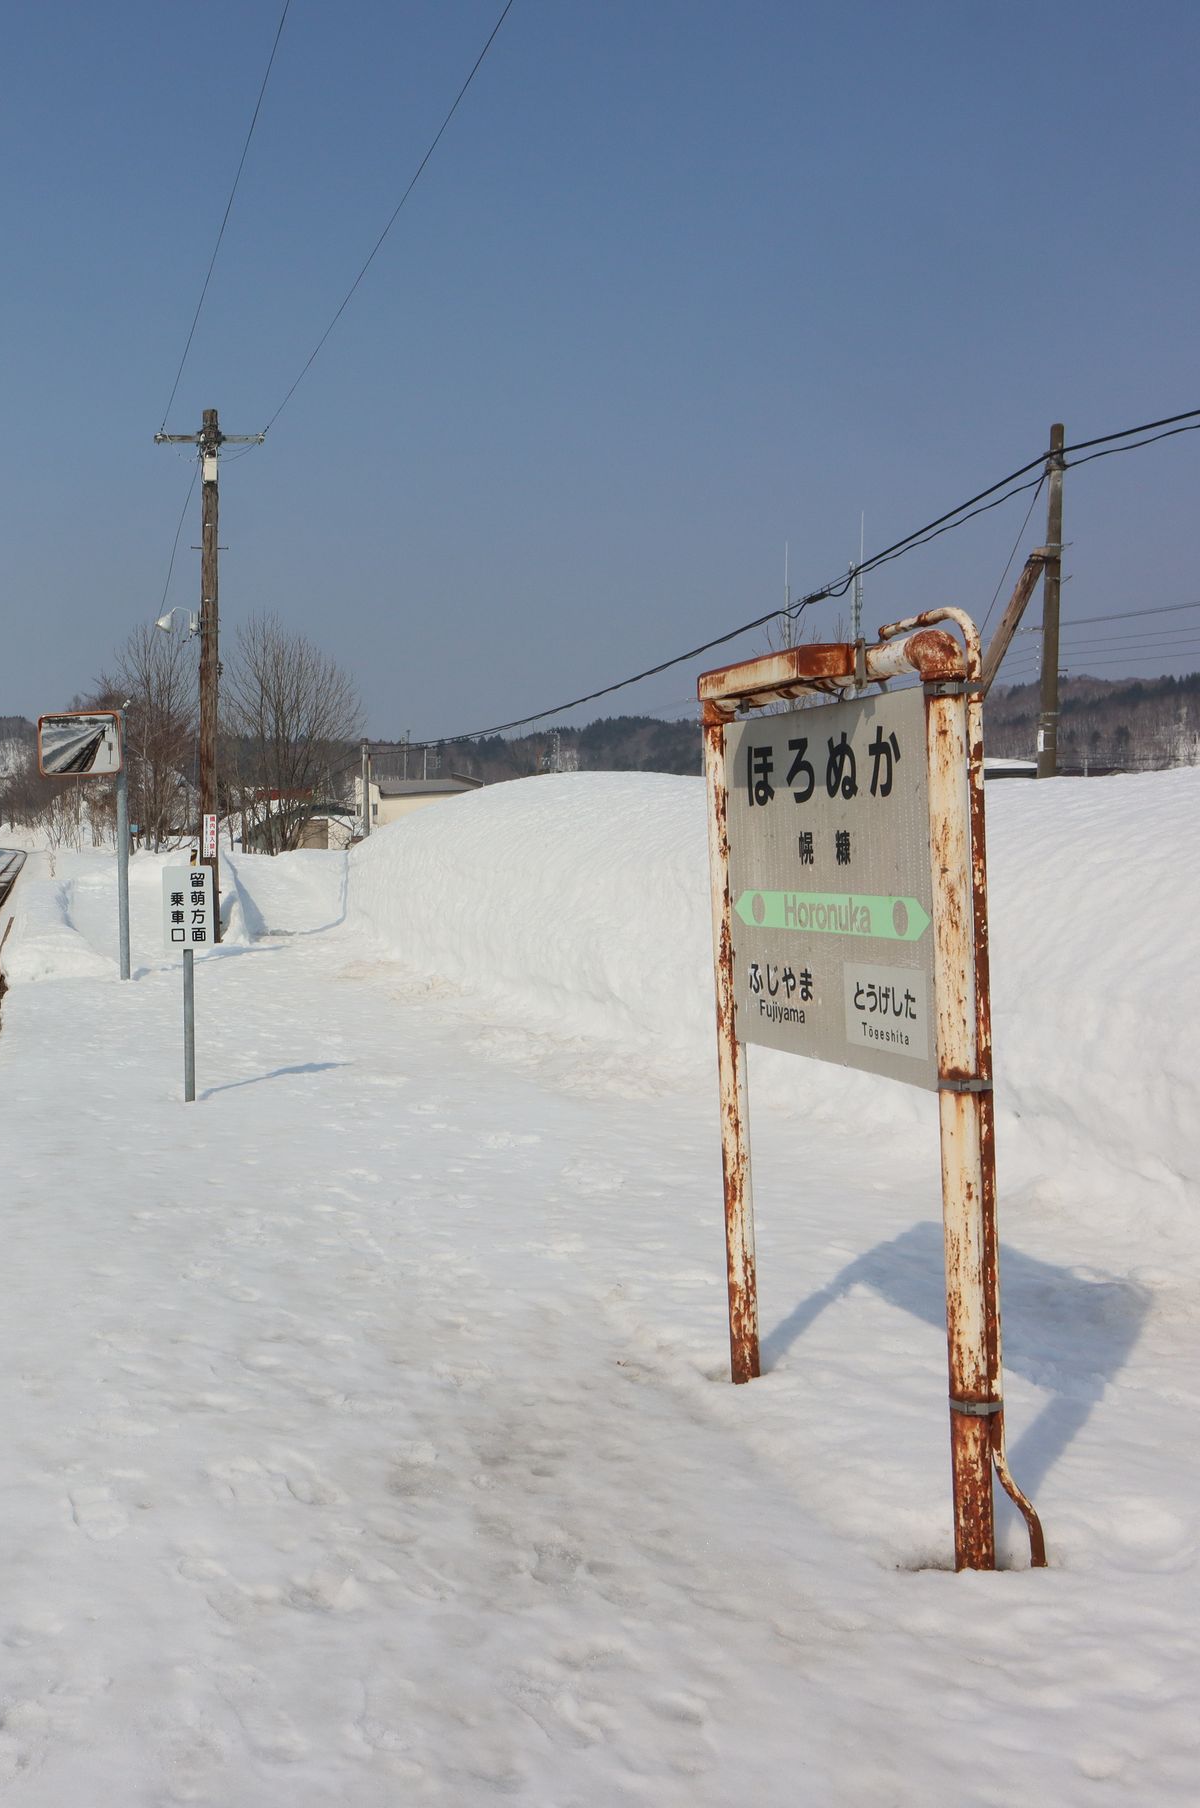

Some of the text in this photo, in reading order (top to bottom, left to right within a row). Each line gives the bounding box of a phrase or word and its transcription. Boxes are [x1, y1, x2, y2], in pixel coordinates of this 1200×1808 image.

[747, 725, 901, 807] ほろぬか
[798, 830, 851, 866] 幌糠
[170, 892, 185, 942] 乗車口
[190, 872, 206, 942] 留萌方面
[784, 894, 871, 934] Horonuka
[749, 963, 813, 1001] ふじやま
[853, 982, 917, 1019] とうげした
[759, 999, 806, 1024] Fujiyama
[861, 1022, 909, 1046] Tōgeshita
